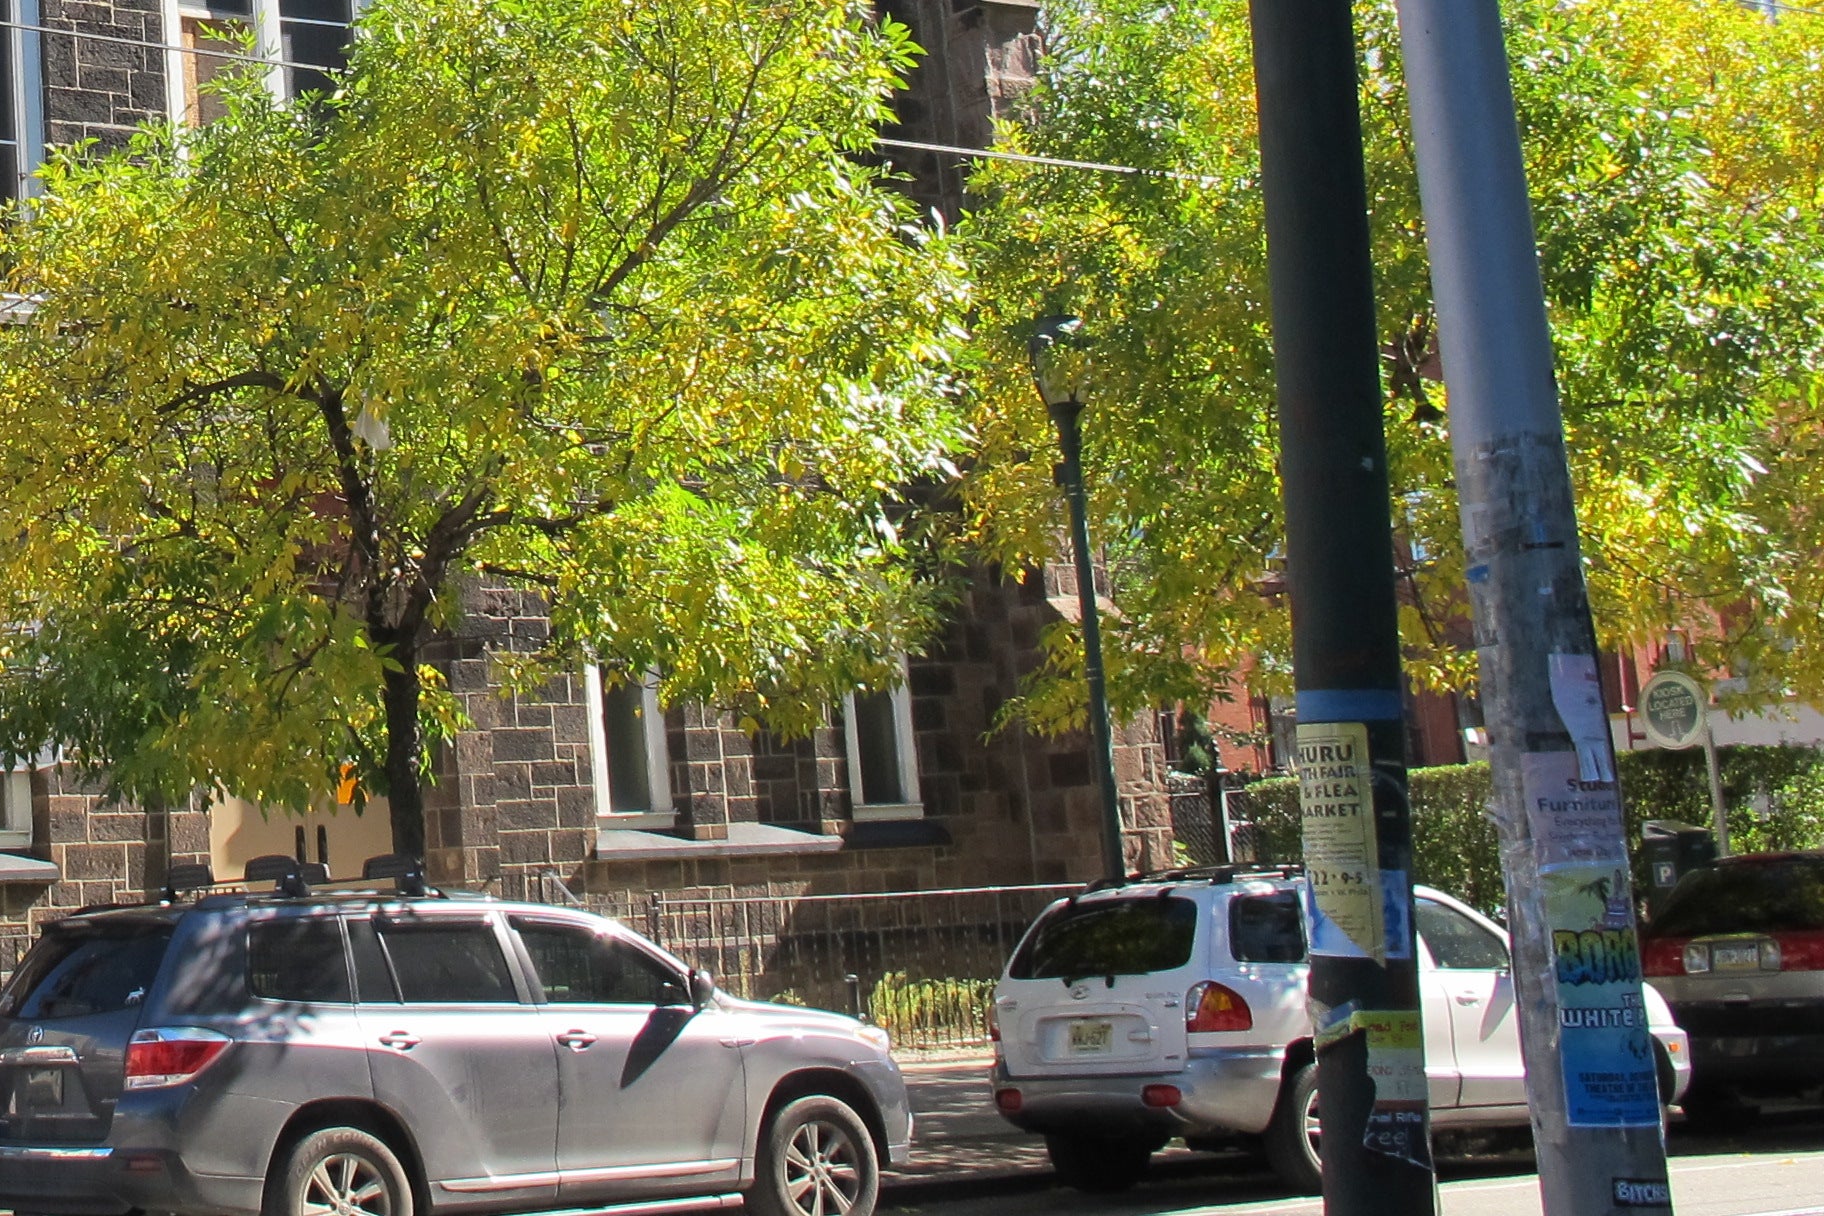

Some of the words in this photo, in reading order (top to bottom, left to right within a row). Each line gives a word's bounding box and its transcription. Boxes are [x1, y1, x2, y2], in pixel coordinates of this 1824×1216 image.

[1650, 695, 1692, 712] LOCATED
[1660, 707, 1686, 721] HERE
[1319, 765, 1357, 780] FAIR
[1314, 783, 1358, 799] FLEA
[1659, 866, 1672, 883] P
[1560, 1007, 1635, 1029] WHITE
